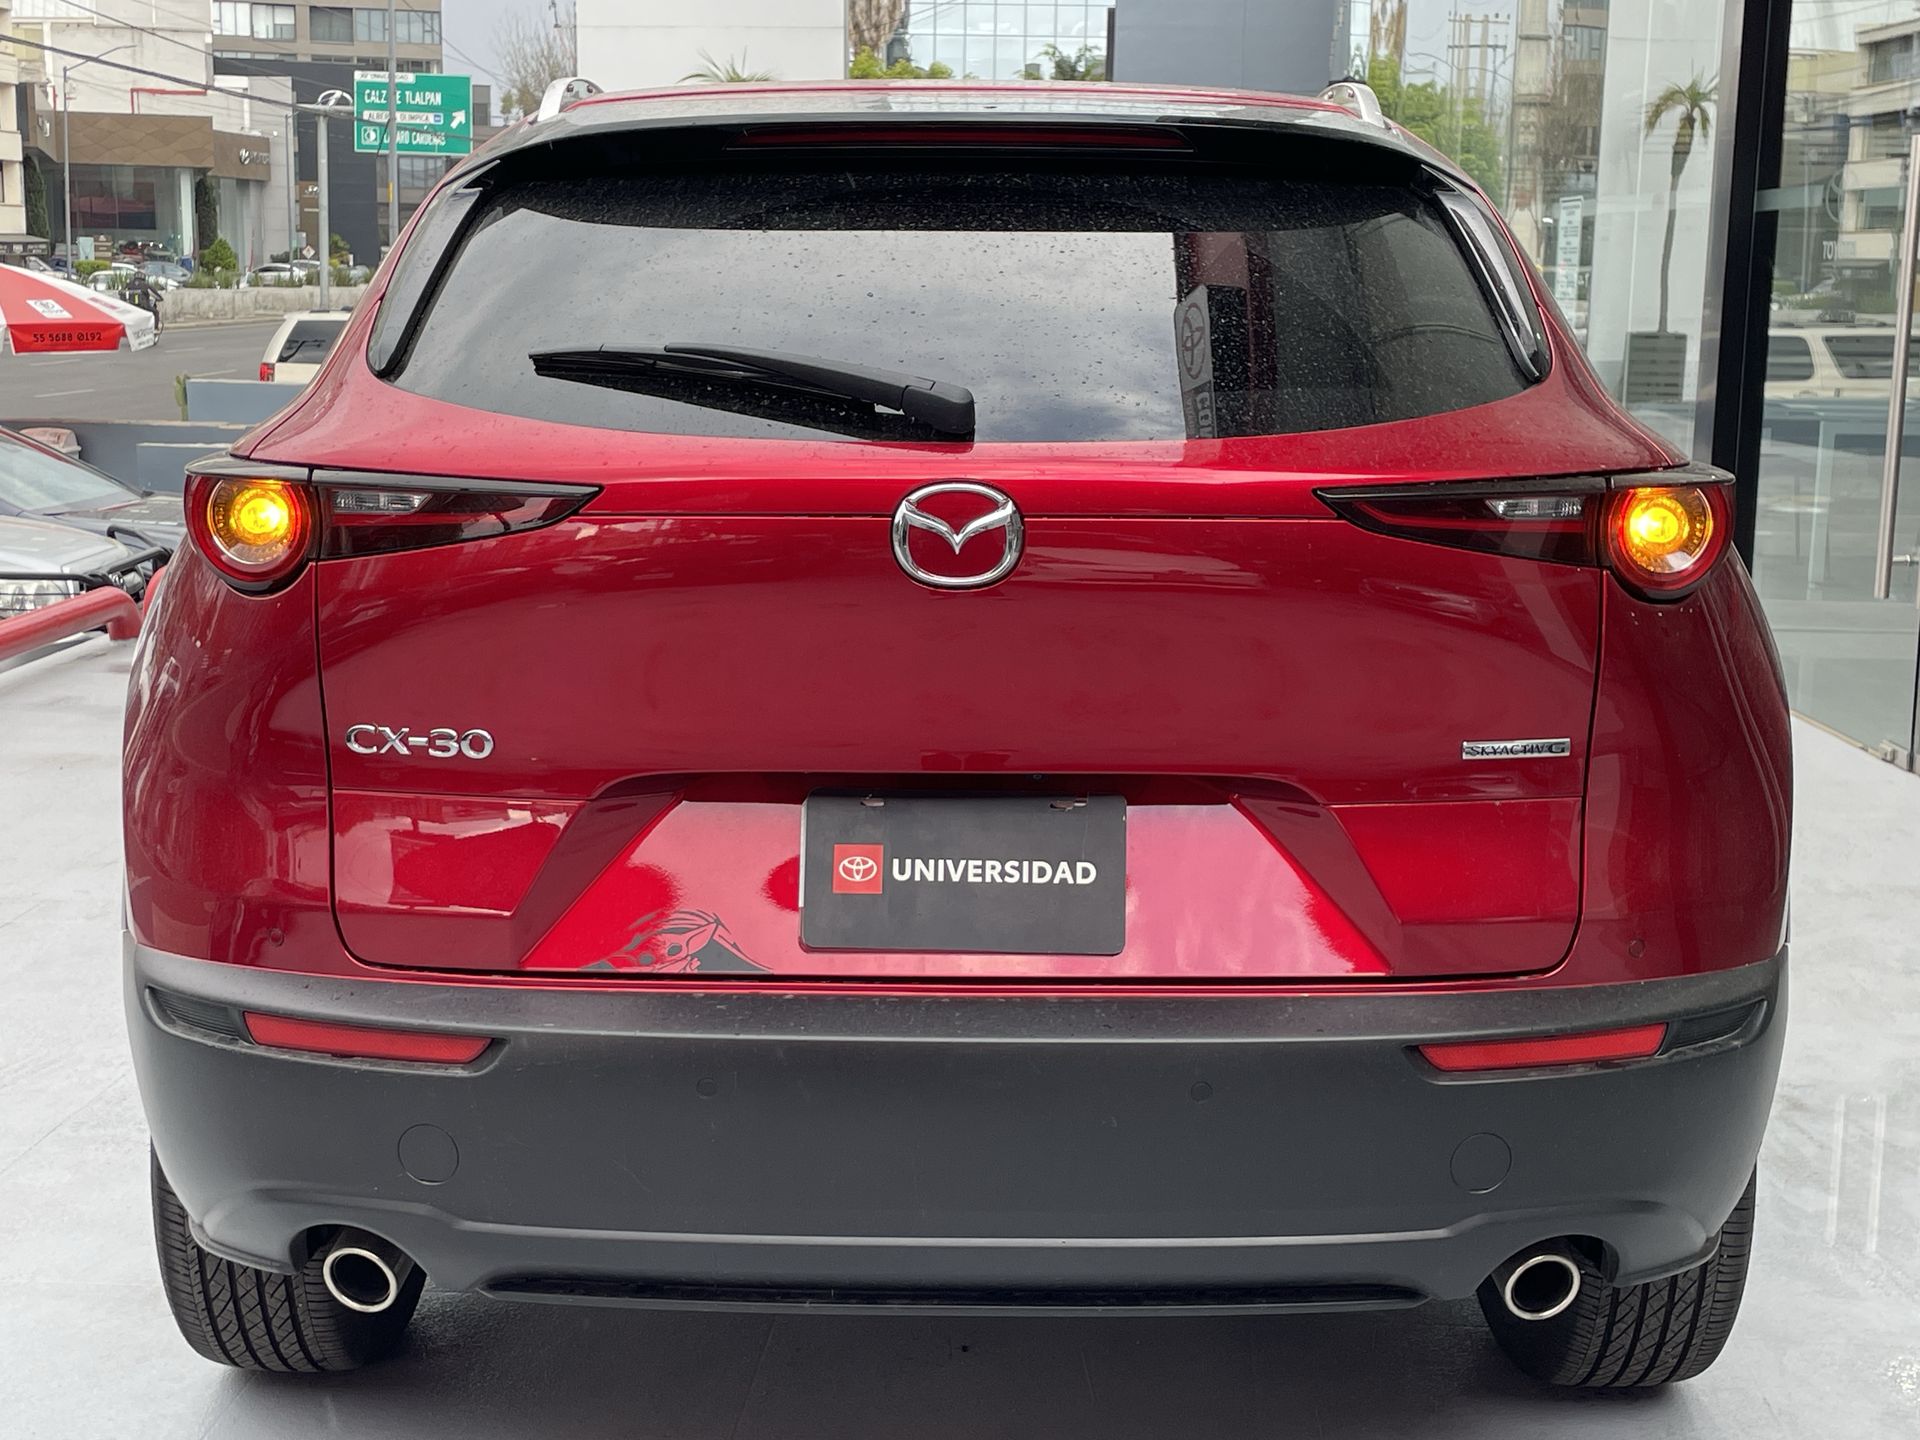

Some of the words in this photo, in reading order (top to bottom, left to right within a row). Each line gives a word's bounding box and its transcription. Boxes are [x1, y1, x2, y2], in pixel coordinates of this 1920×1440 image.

[364, 89, 387, 104] CALZ
[405, 91, 441, 106] TLALPAN
[33, 333, 45, 343] 55
[49, 332, 73, 343] 5688
[77, 332, 102, 342] 0192
[345, 723, 495, 759] CX-30
[891, 858, 1097, 885] UNIVERSIDAD
